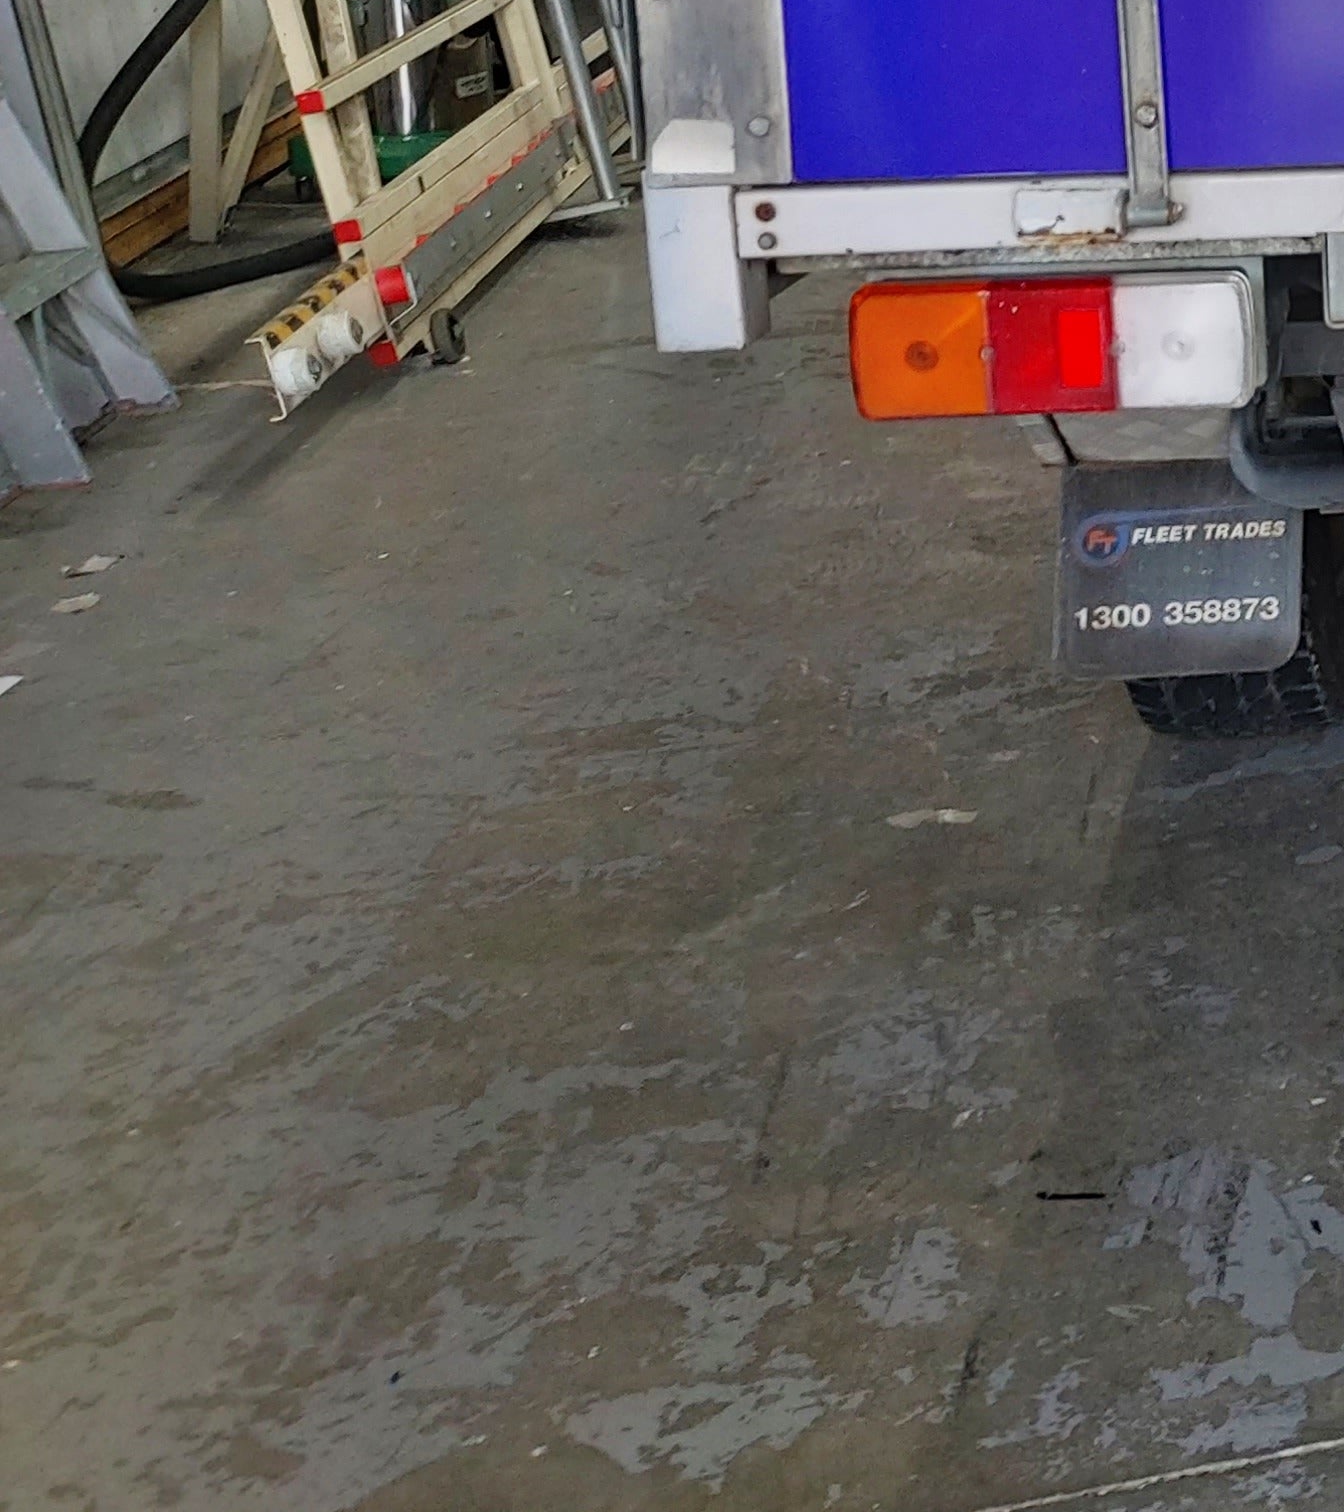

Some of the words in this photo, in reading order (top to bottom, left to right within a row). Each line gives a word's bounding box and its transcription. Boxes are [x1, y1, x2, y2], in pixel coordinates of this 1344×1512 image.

[1131, 524, 1198, 545] FLEET
[1202, 520, 1286, 541] TRADES
[1074, 603, 1151, 630] 1300
[1162, 596, 1280, 626] 358873
